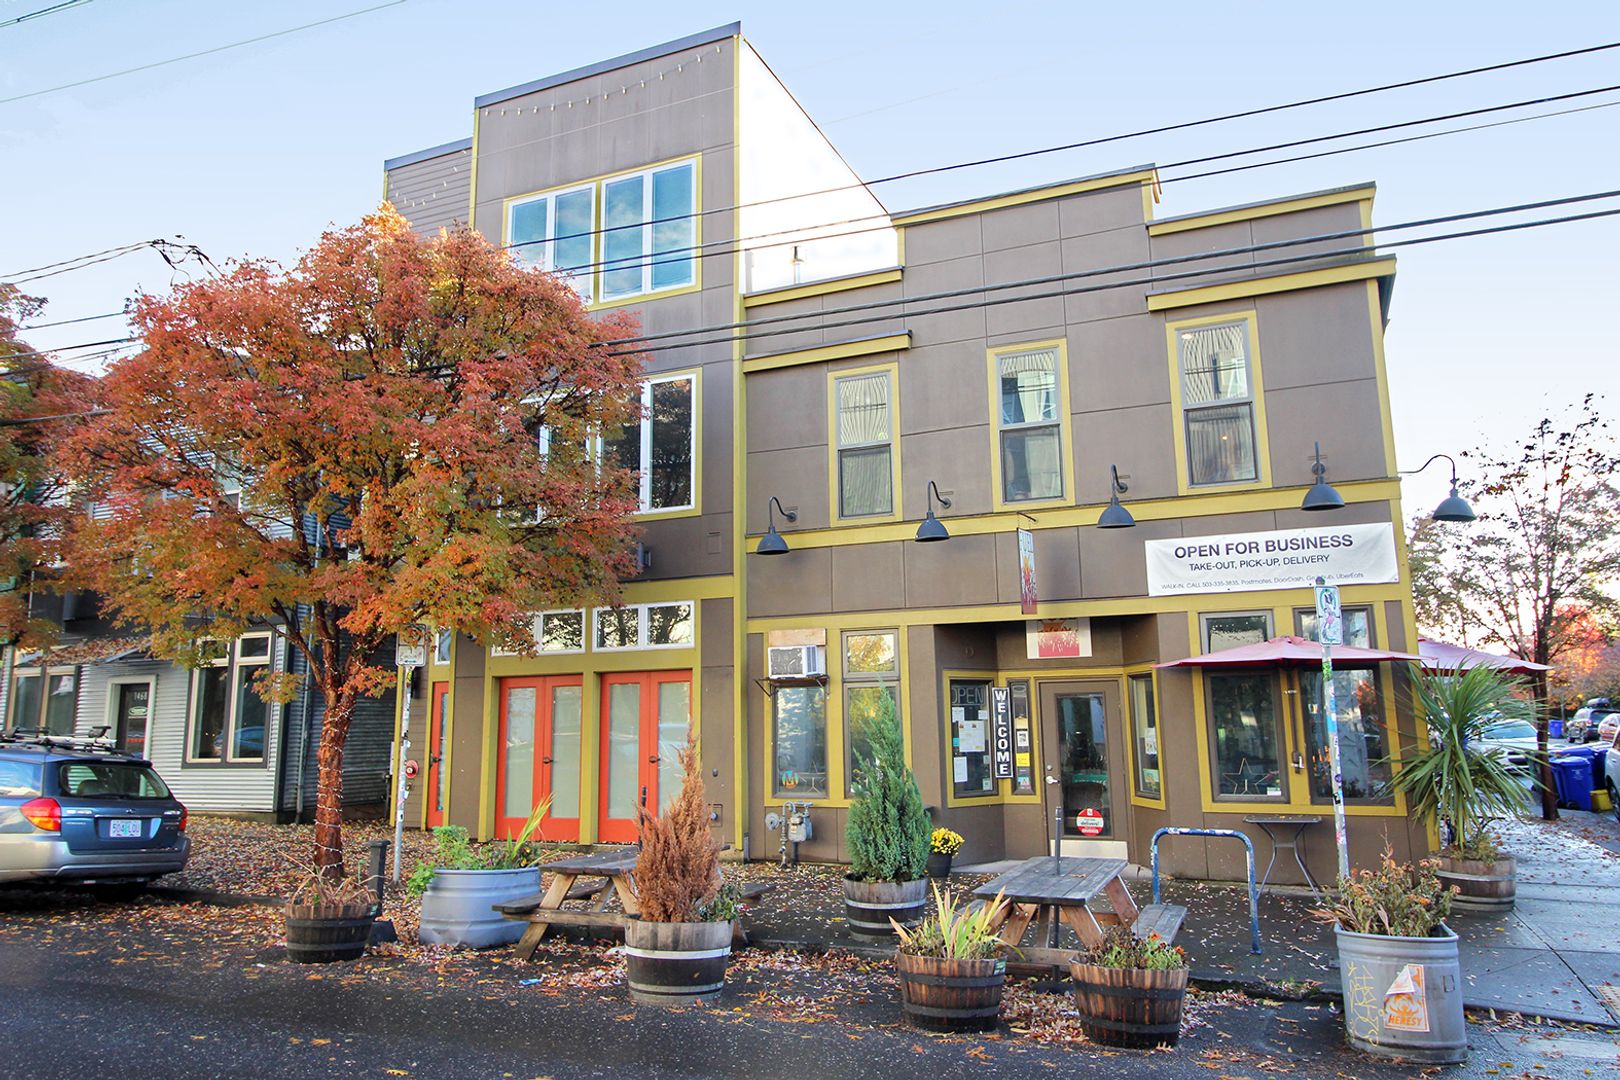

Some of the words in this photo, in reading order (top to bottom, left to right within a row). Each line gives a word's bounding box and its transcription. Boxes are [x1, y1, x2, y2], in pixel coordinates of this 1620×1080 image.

[1174, 544, 1220, 559] OPEN
[1225, 541, 1260, 556] FOR
[1265, 534, 1354, 553] BUSINESS
[1189, 560, 1237, 572] TAKE-OUT,
[1239, 557, 1280, 568] PICK-UP,
[1283, 554, 1330, 565] DELIVERY
[994, 690, 1010, 775] WELCOME
